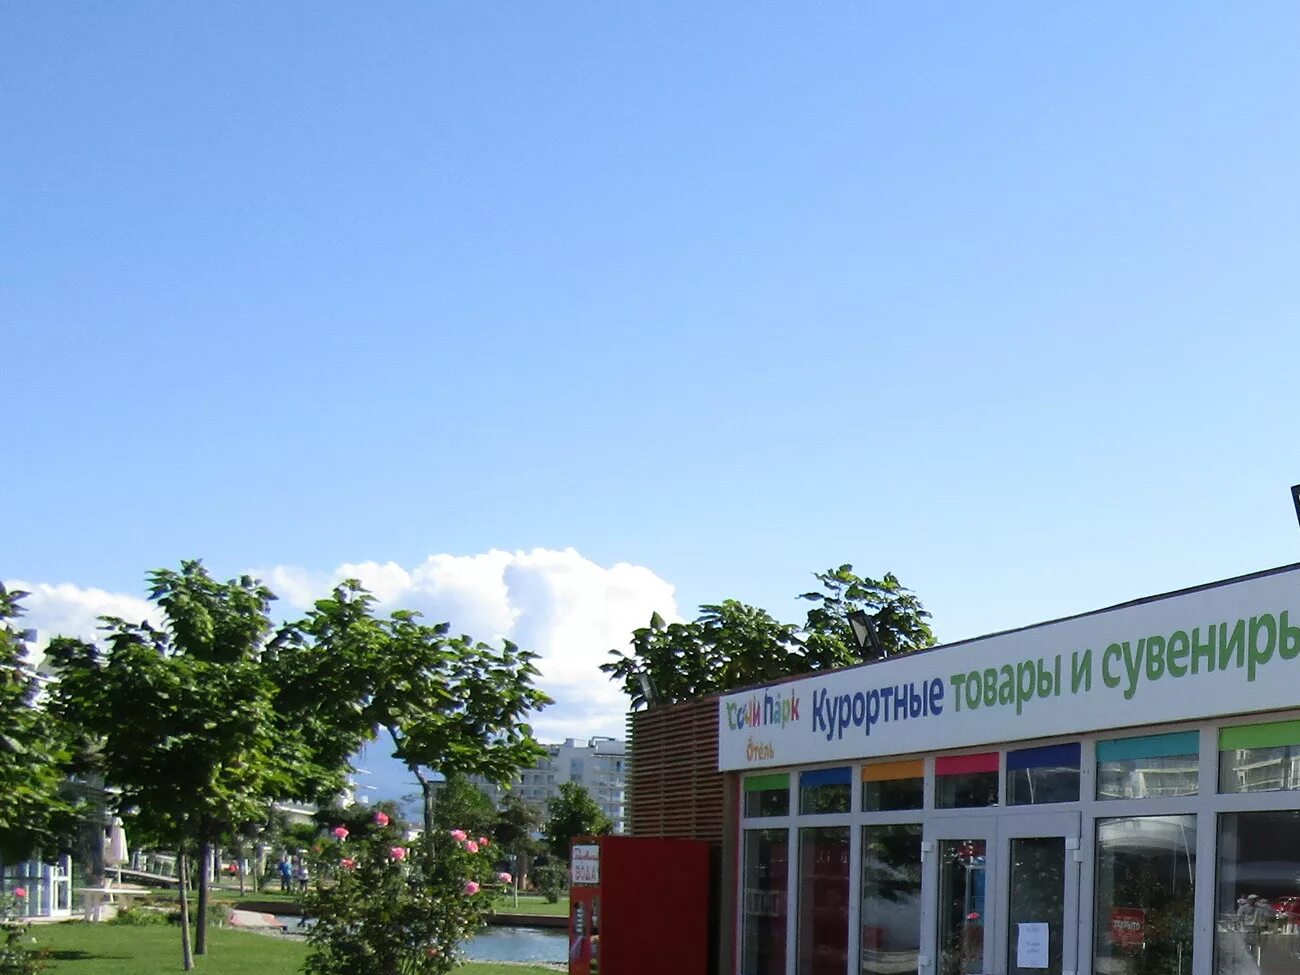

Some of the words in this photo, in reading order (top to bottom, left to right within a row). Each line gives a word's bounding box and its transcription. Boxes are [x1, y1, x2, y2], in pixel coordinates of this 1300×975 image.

[812, 677, 945, 741] Курортные
[950, 654, 1062, 715] товары
[1071, 649, 1092, 695] и
